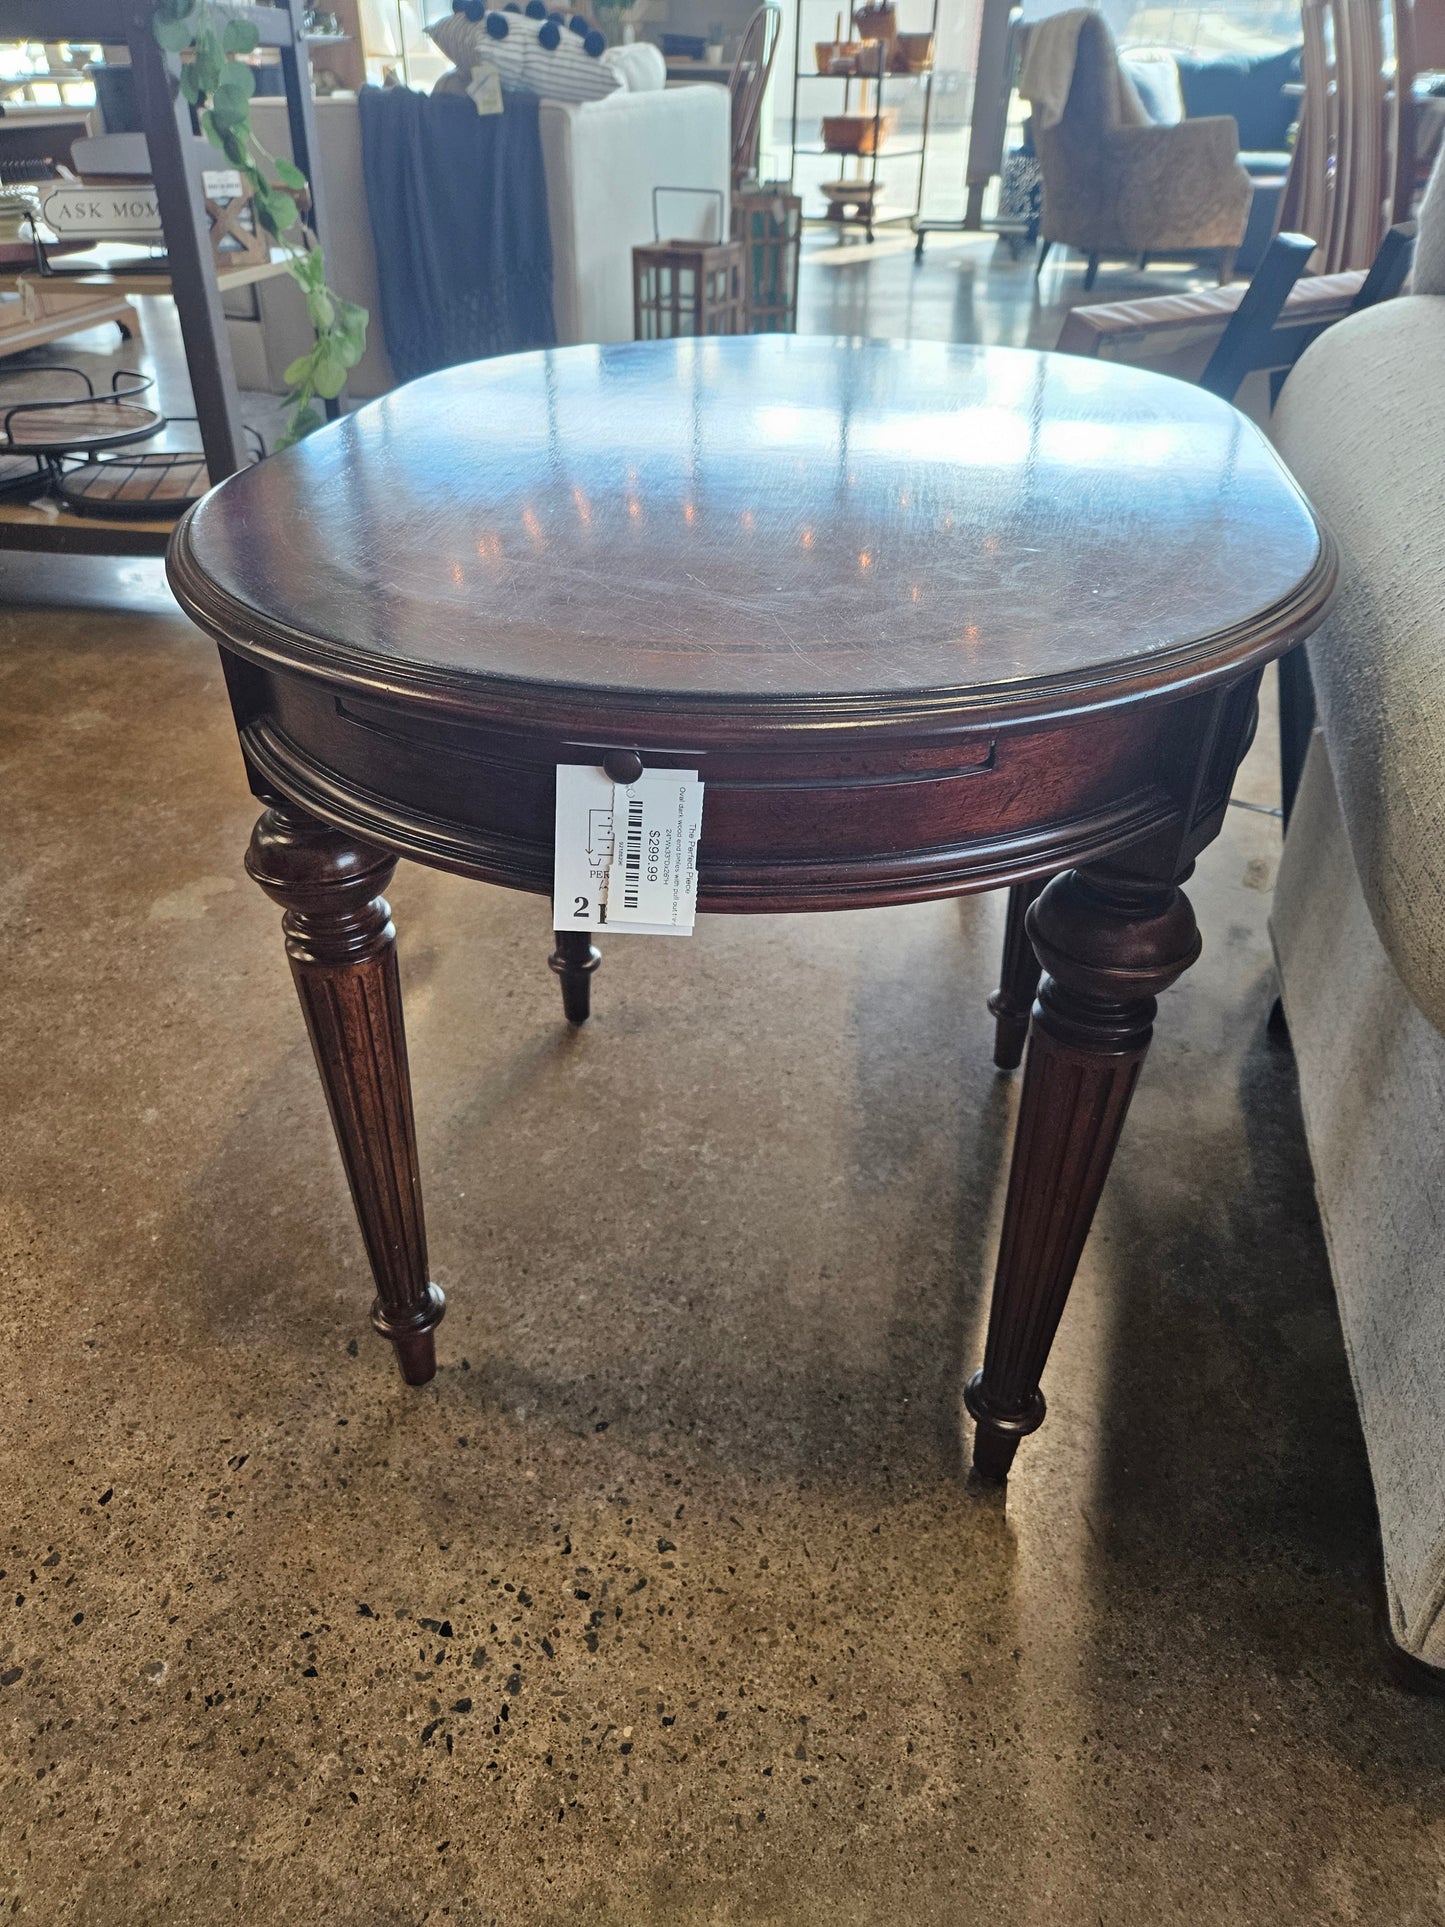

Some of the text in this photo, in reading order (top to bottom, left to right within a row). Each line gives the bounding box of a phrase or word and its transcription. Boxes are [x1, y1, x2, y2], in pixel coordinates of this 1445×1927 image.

[59, 202, 104, 219] ASK
[679, 786, 687, 802] Oval
[677, 804, 685, 819] dark
[676, 819, 684, 838] wood
[675, 839, 683, 852] end
[646, 829, 661, 882] $299.99
[684, 823, 697, 895] The Perfect Piece
[673, 874, 681, 887] with
[672, 888, 681, 901] pull
[573, 896, 589, 917] 2
